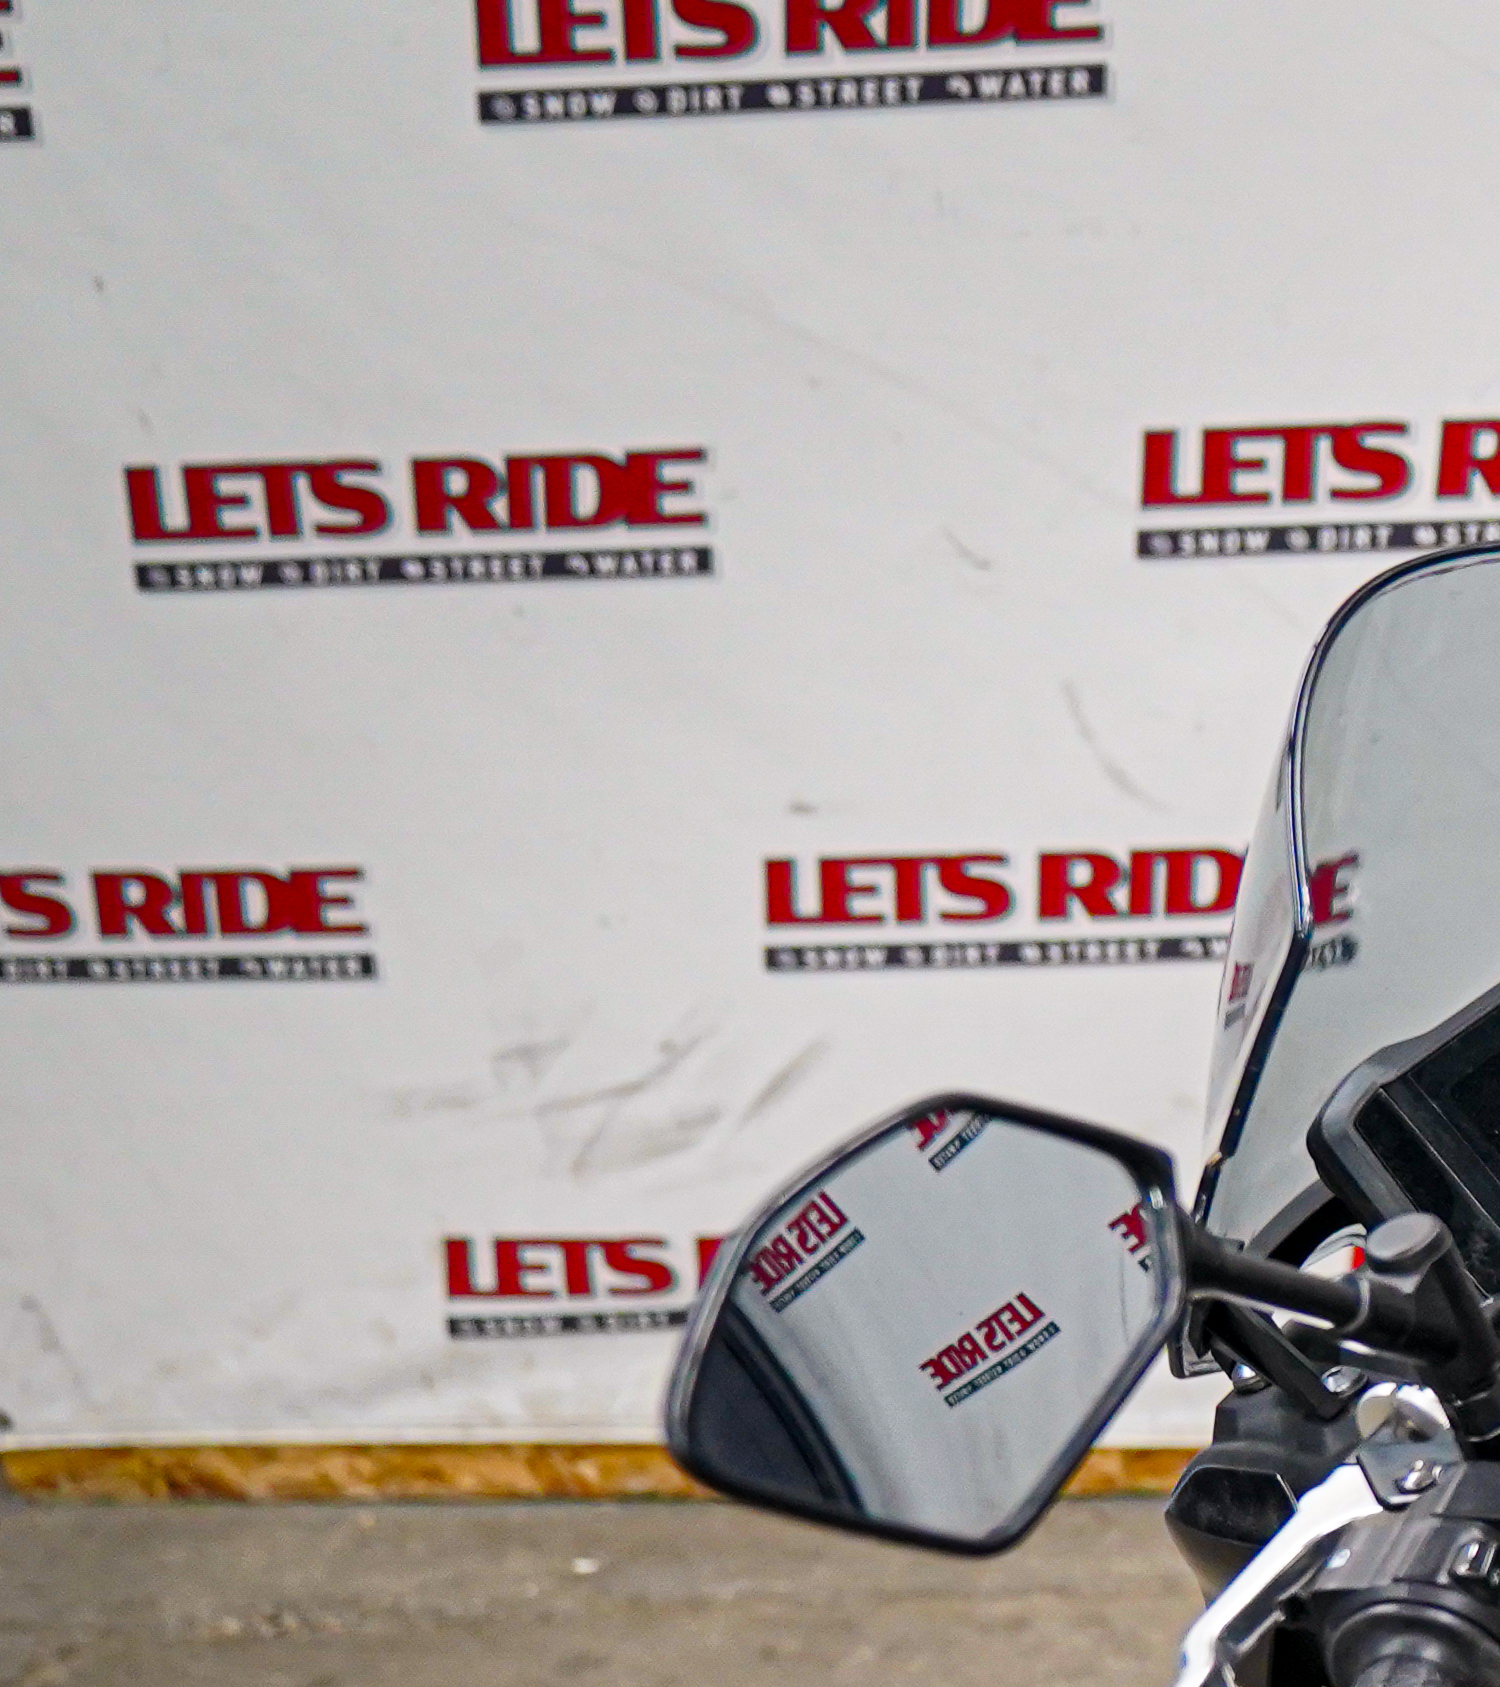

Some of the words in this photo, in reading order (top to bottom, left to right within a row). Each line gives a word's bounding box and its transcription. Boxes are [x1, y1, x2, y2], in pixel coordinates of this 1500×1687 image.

[476, 0, 756, 67] LETS
[521, 93, 616, 118] SNOW
[669, 87, 743, 113] DIRT
[794, 78, 923, 108] STREET
[976, 70, 1091, 98] WATER
[126, 460, 388, 541] LETS
[412, 449, 704, 533] RIDE
[1142, 421, 1410, 507] LETS
[174, 563, 263, 587] SNOW
[309, 559, 381, 583] DIRT
[429, 554, 546, 581] STREET
[596, 549, 699, 575] WATER
[1180, 528, 1270, 553] SNOW
[1318, 524, 1393, 550] DIRT
[94, 868, 366, 937] RIDE
[766, 853, 1012, 925] LETS
[802, 945, 887, 968] SNOW
[931, 943, 1000, 966] DIRT
[1043, 939, 1161, 964] STREET
[446, 1238, 676, 1298] LETS
